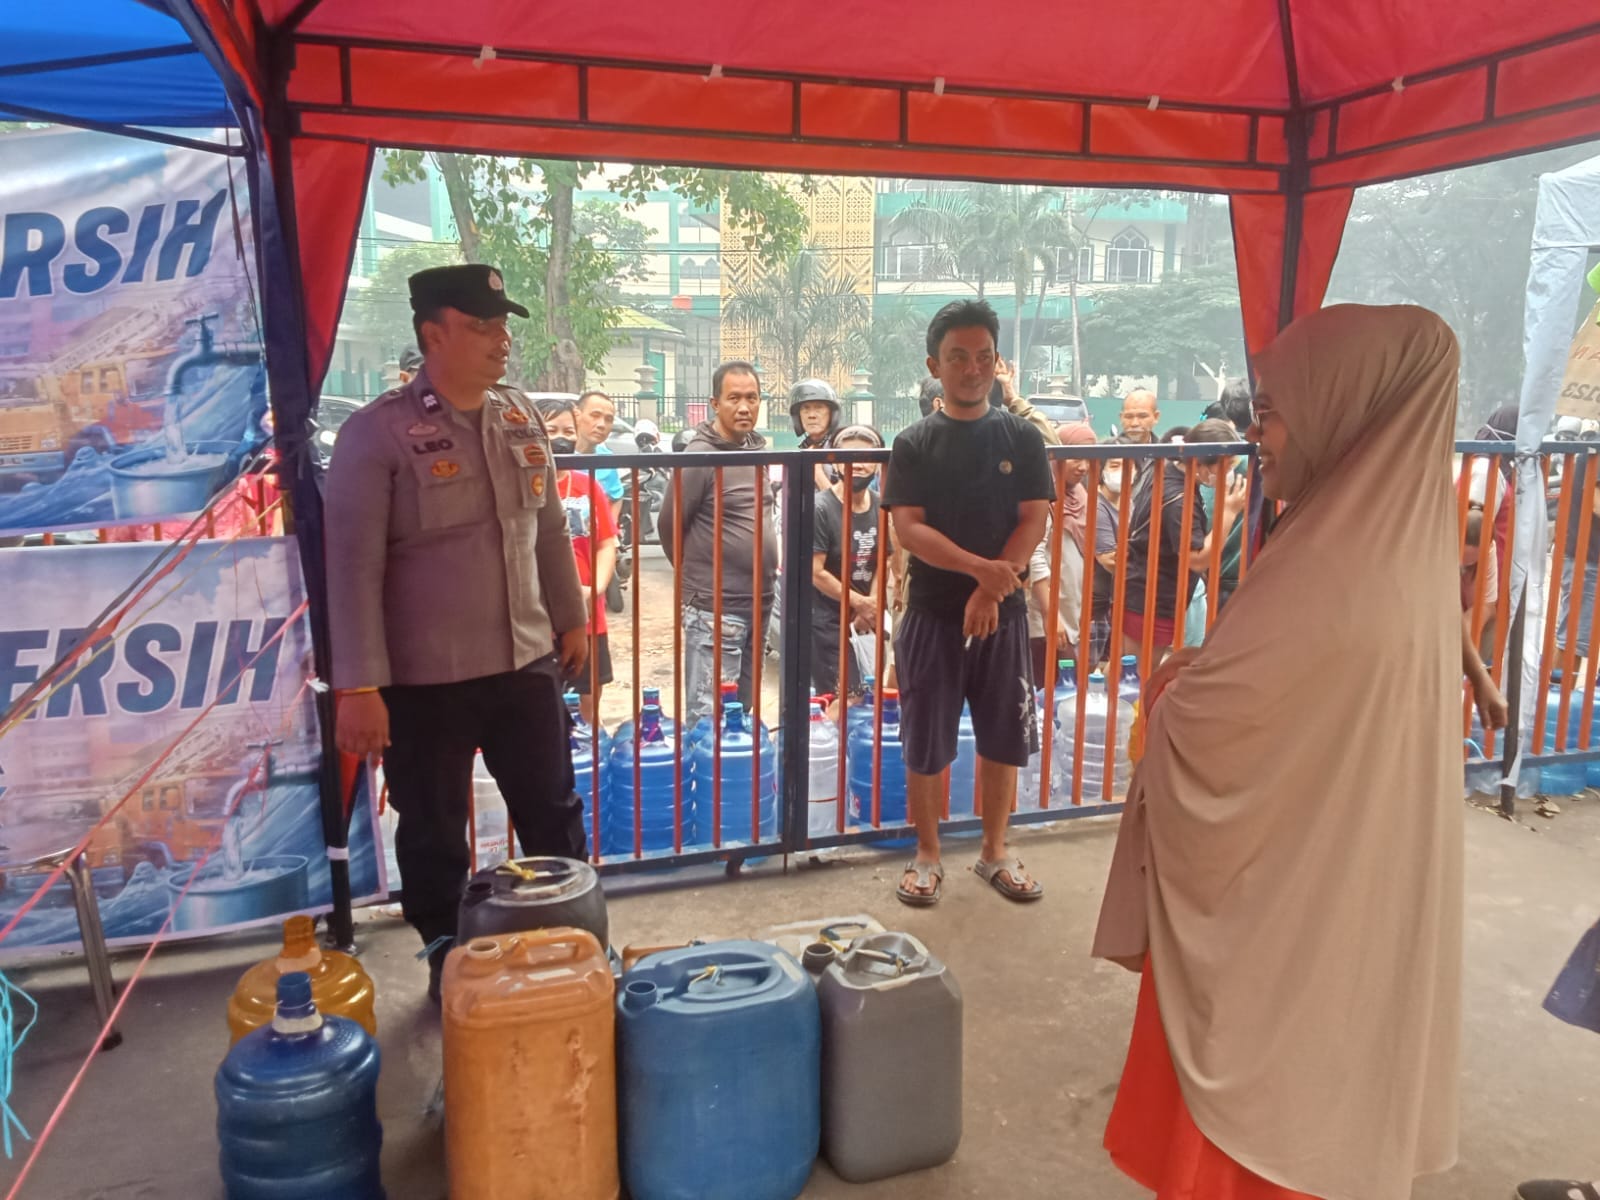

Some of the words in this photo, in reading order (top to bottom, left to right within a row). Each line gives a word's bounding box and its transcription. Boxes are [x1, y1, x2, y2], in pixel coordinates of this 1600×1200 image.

[0, 189, 227, 298] RSIH
[412, 439, 454, 455] LEO
[0, 618, 286, 719] ERSIH
